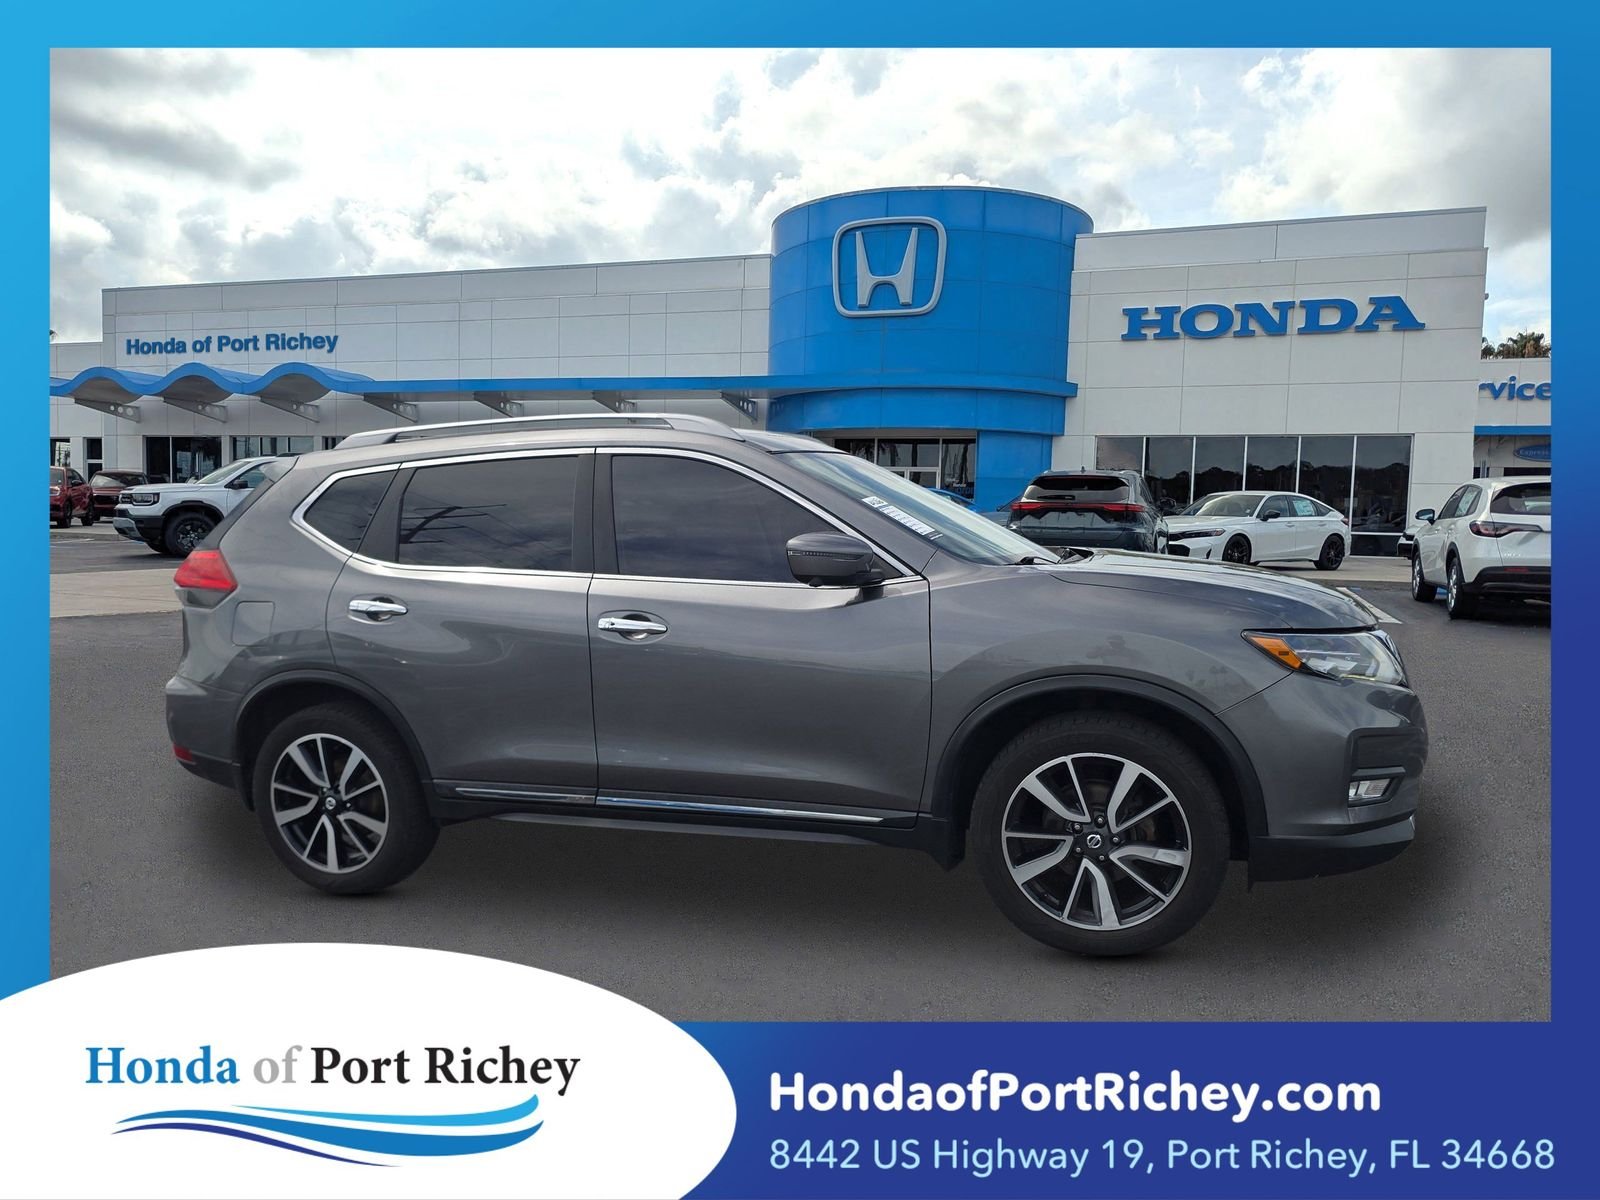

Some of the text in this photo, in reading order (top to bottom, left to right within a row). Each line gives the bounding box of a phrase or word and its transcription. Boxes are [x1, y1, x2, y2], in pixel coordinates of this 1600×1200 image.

[1121, 296, 1425, 341] HONDA
[125, 332, 339, 355] Honda of Port Richey
